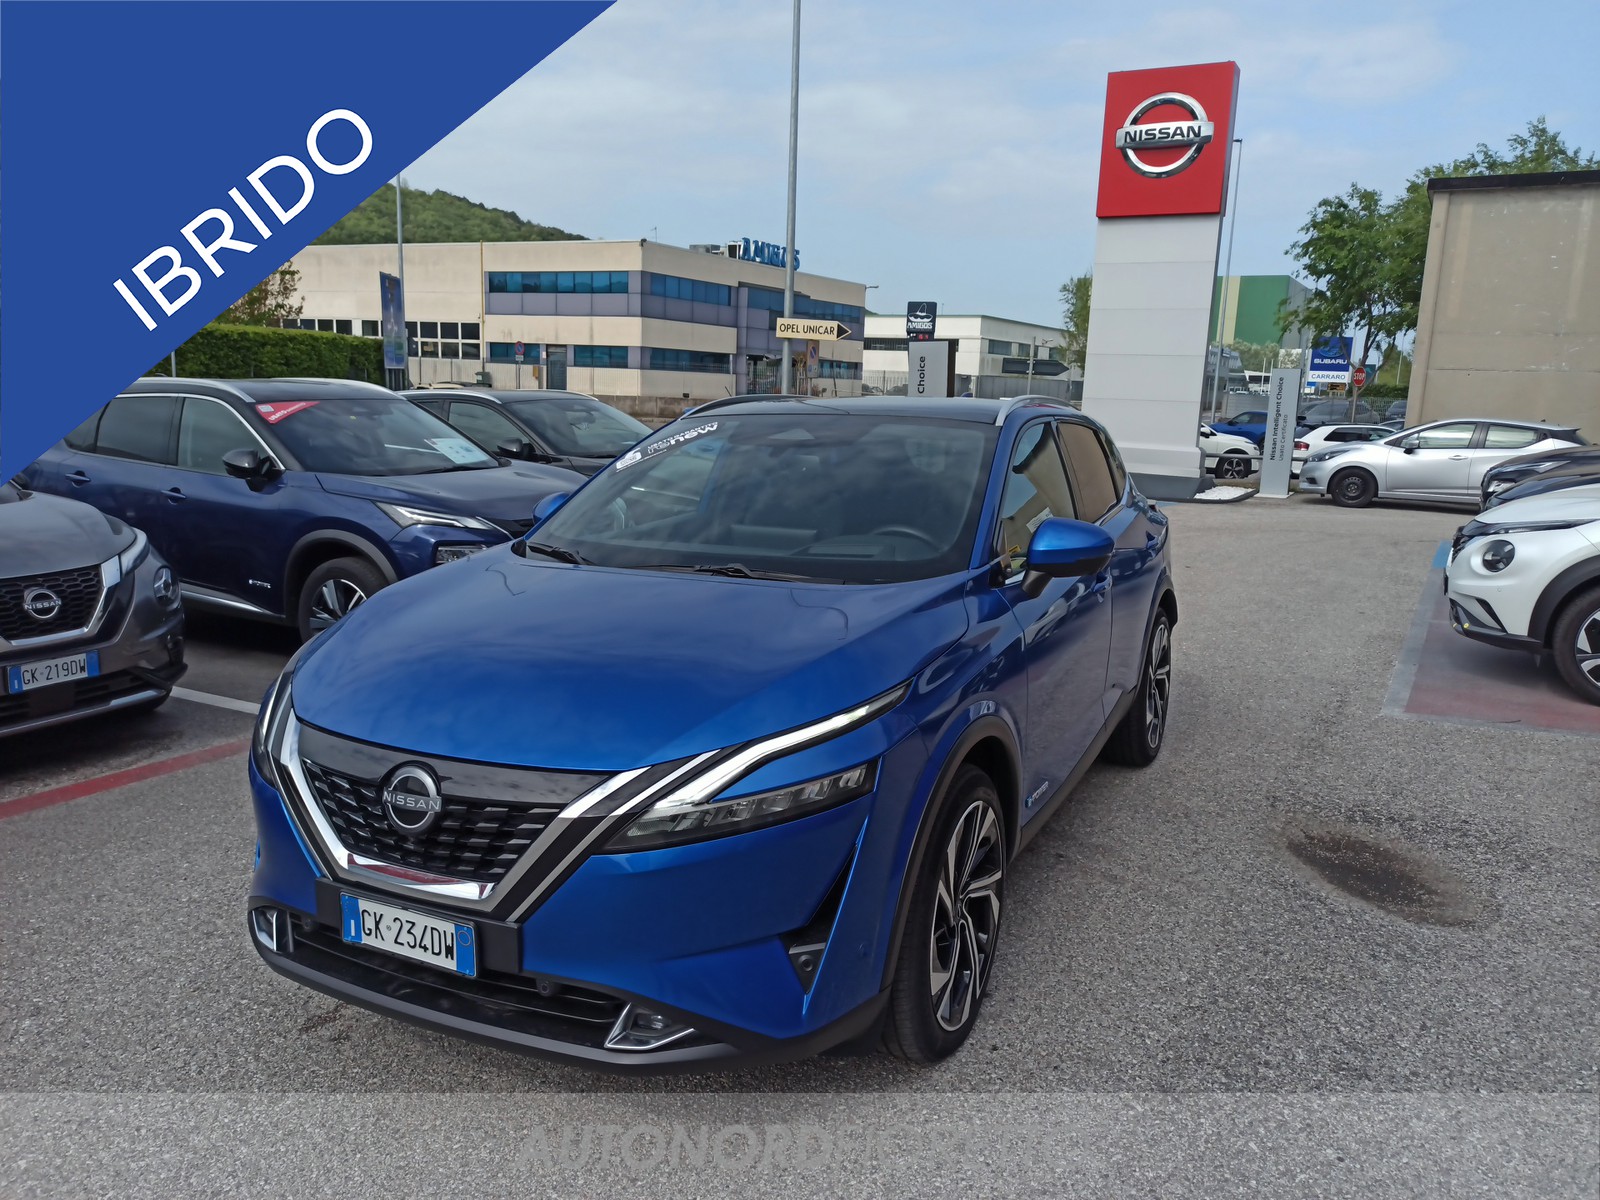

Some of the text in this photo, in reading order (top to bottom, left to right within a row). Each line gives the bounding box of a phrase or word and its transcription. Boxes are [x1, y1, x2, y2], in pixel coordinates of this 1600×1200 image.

[1124, 125, 1201, 143] NISSAN
[779, 323, 835, 335] OPEL UNICAR
[907, 321, 933, 329] AMIGOS
[917, 356, 926, 394] Choice
[1353, 372, 1366, 380] STOP
[1269, 376, 1285, 461] Nissan Intelligent Choice
[24, 600, 62, 610] NISSAN
[383, 791, 440, 810] NISSAN
